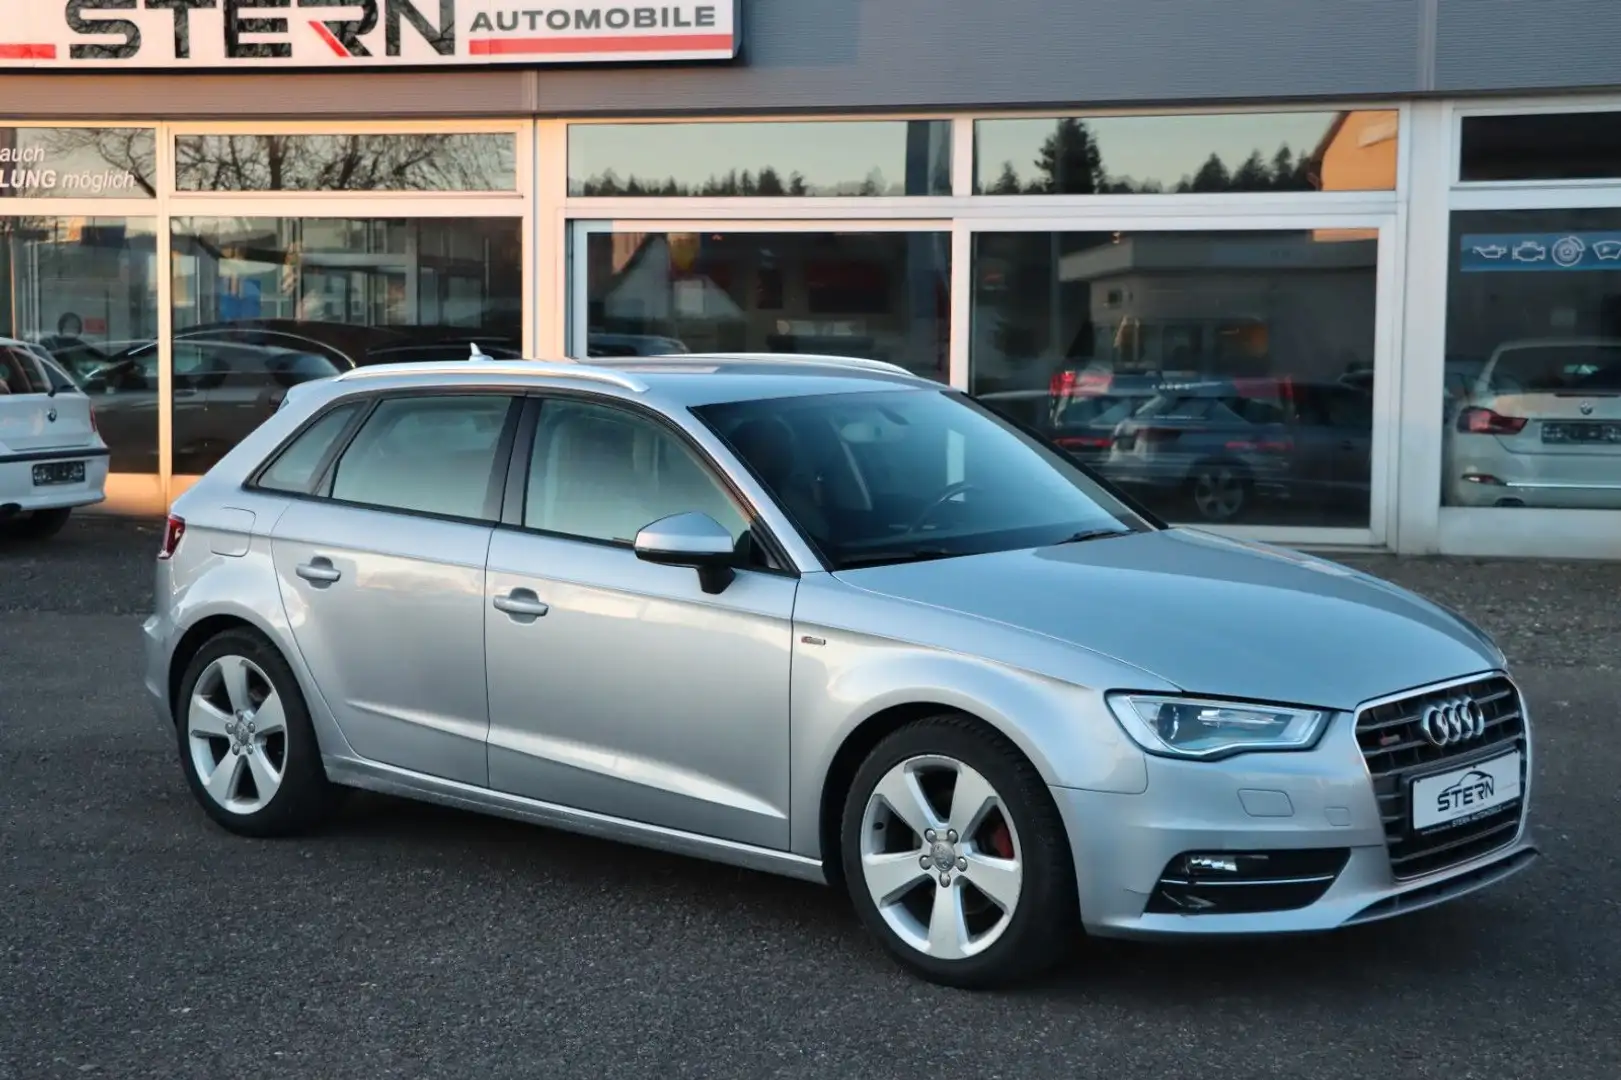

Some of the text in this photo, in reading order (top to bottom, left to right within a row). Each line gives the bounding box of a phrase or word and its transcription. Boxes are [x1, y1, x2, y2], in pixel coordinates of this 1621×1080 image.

[65, 0, 716, 59] STERN AUTOMOBILE
[0, 144, 45, 162] auch
[62, 169, 135, 193] möglich
[1437, 781, 1495, 812] STERN
